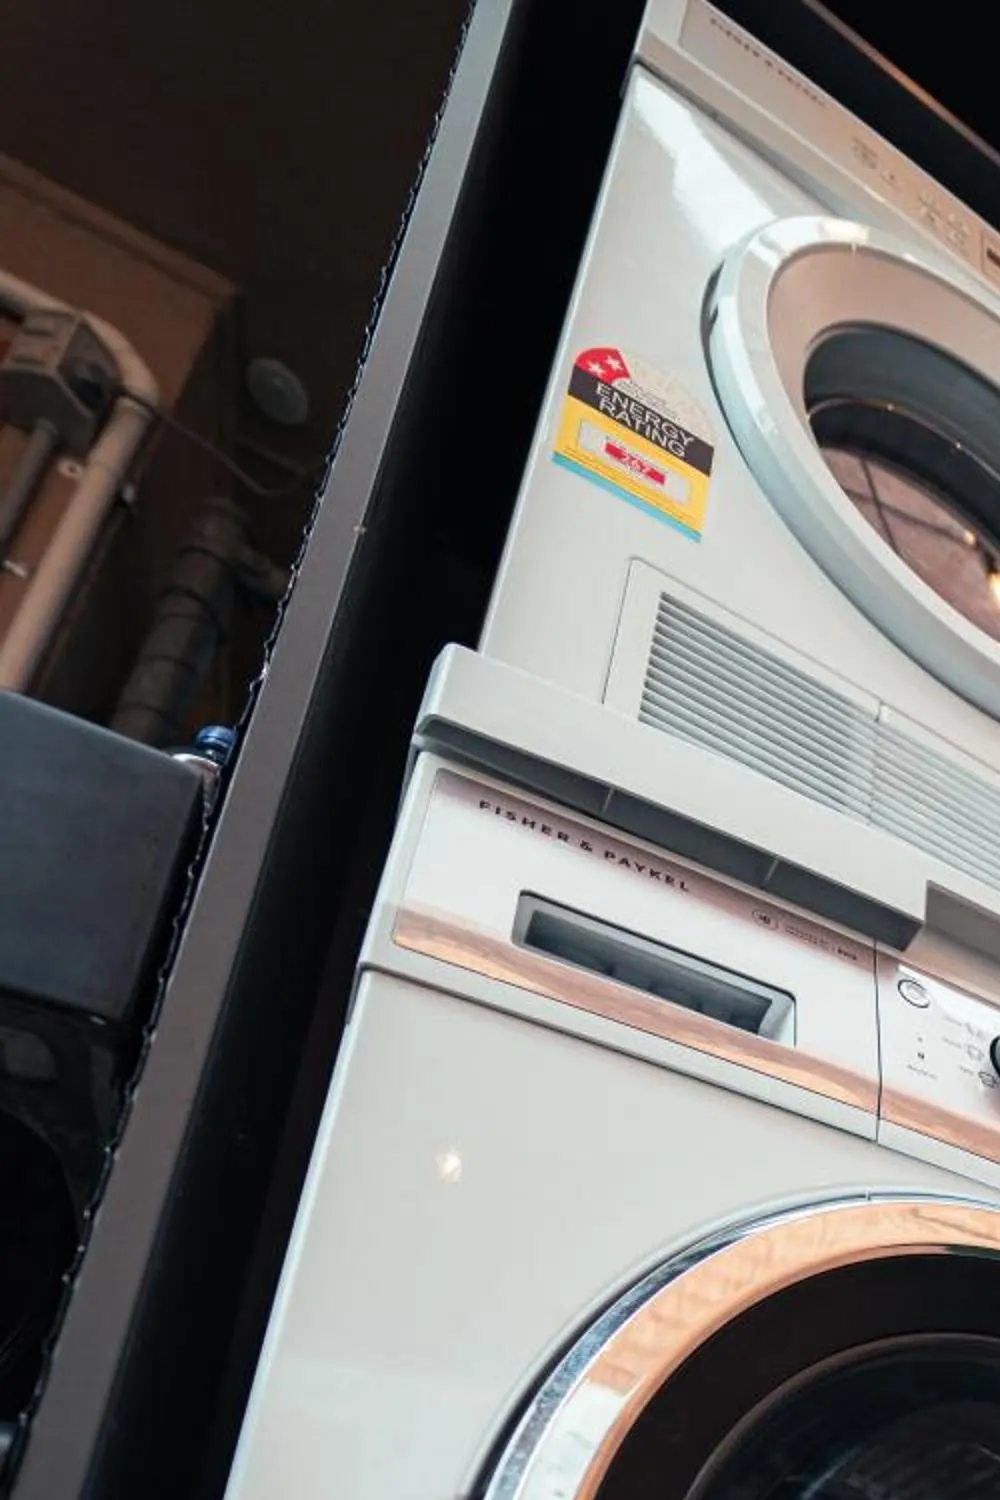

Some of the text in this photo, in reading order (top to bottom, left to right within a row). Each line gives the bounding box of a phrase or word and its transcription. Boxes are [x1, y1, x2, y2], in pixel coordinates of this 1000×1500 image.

[597, 382, 695, 447] ENERGY
[600, 397, 686, 458] RATING
[479, 800, 689, 892] FISHER & PAYKEL
